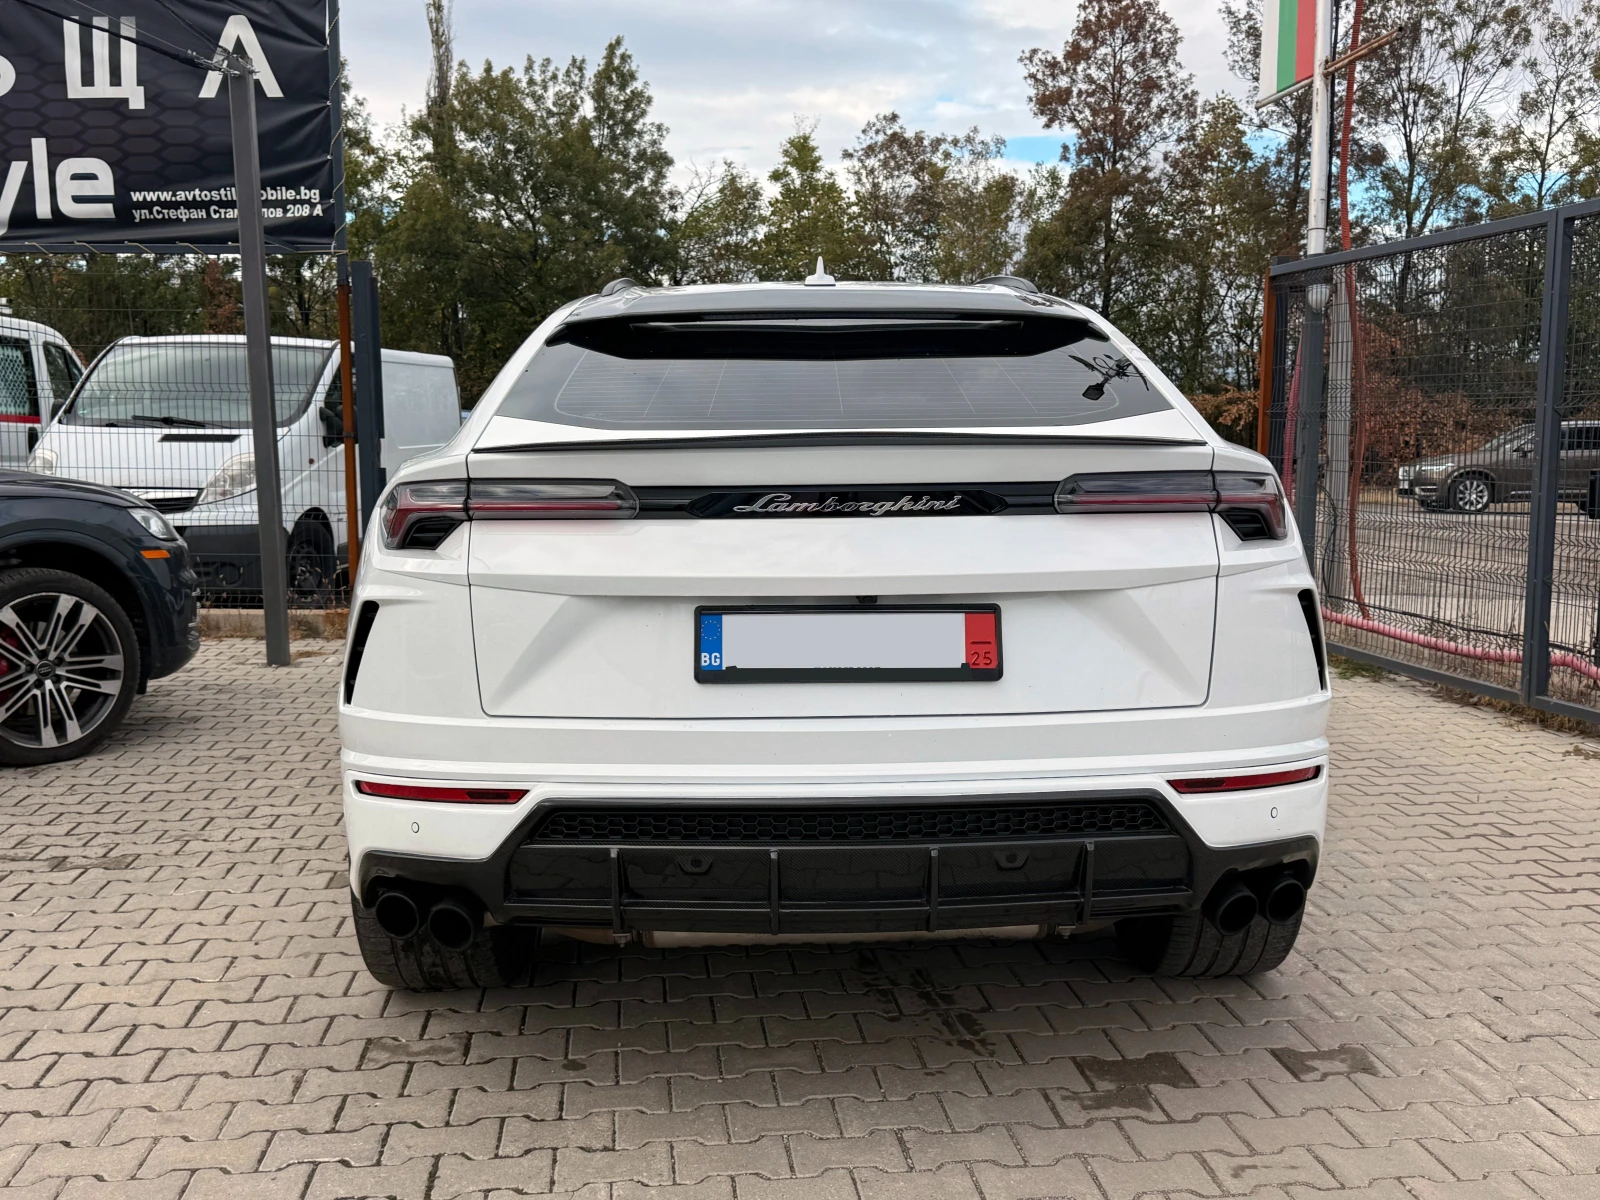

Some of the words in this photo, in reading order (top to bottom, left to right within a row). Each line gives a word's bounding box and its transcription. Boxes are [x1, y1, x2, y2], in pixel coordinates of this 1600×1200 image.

[132, 206, 207, 222] ул.Стефан
[286, 204, 310, 217] 208
[732, 493, 963, 516] Lamborghini
[701, 652, 720, 666] BG
[970, 651, 993, 666] 25
